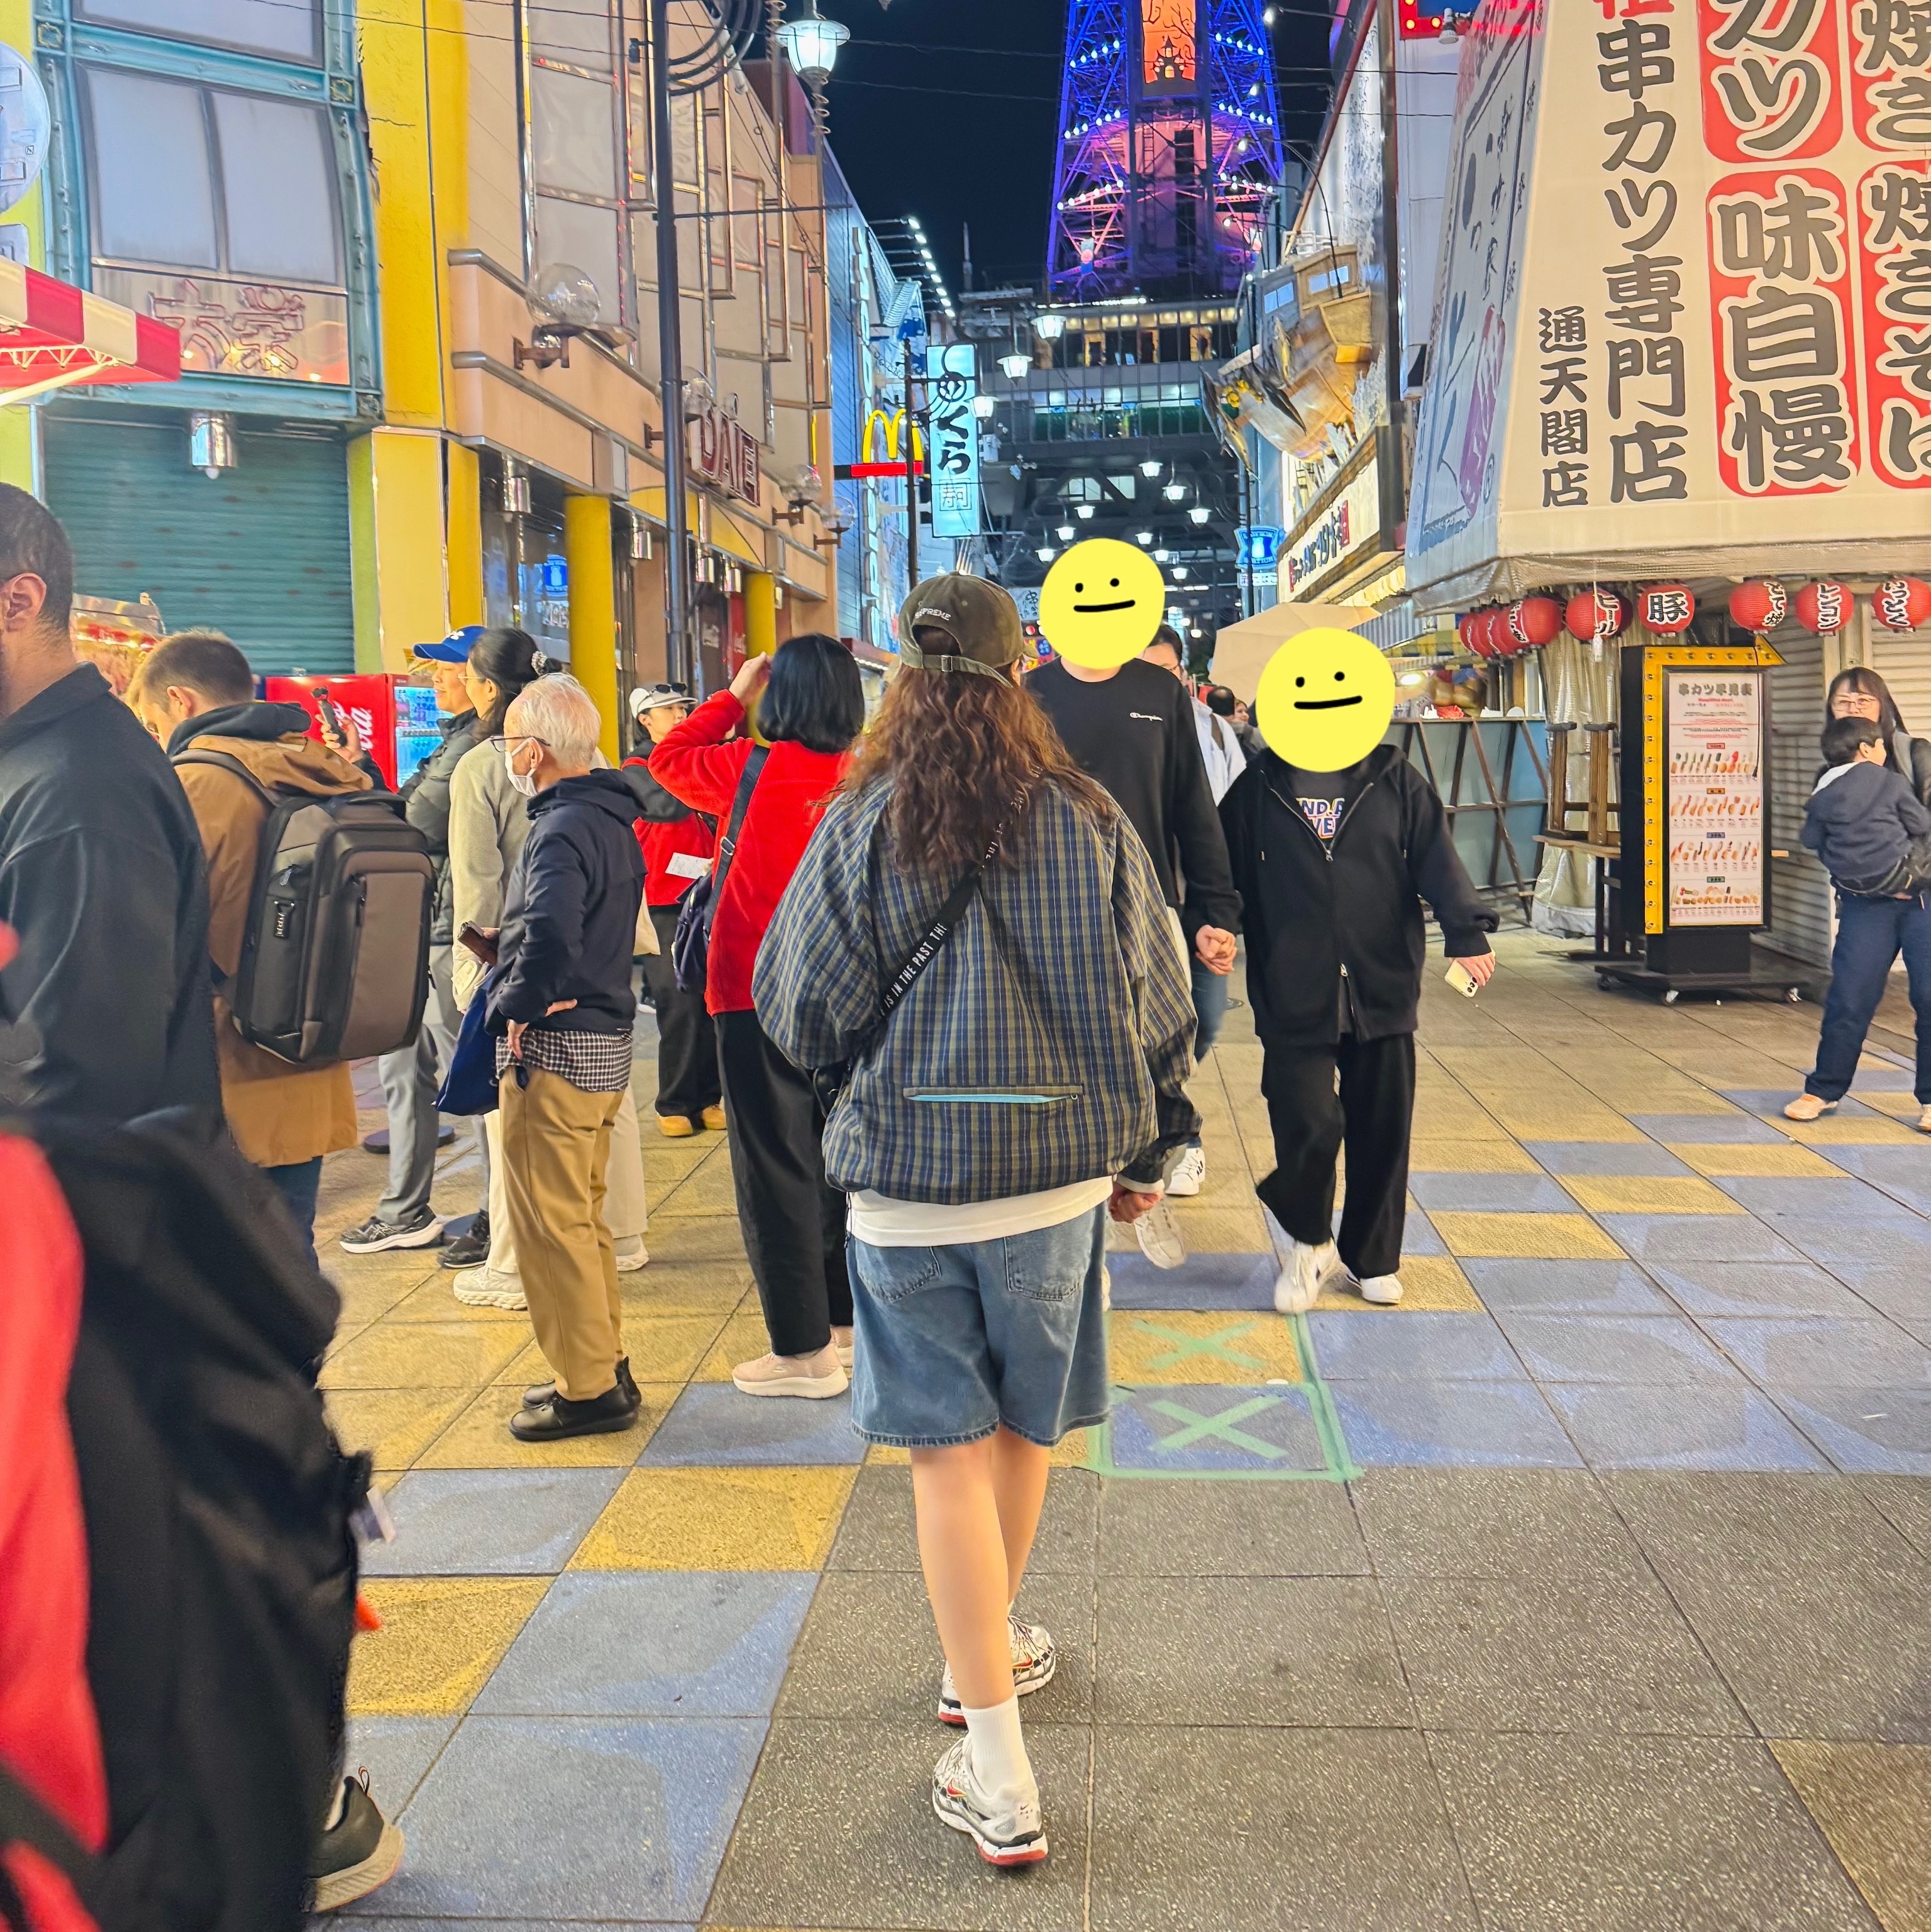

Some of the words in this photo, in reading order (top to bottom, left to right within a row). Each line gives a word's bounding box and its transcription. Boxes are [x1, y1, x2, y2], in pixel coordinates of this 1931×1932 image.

[1713, 0, 1821, 152] カツ
[1595, 19, 1688, 504] 串カツ専門店
[1717, 183, 1851, 487] 味自慢
[1537, 306, 1589, 508] 通天閣店
[1649, 593, 1690, 624] 豚
[891, 982, 903, 997] IN
[899, 964, 916, 985] THE
[912, 941, 934, 967] PAST
